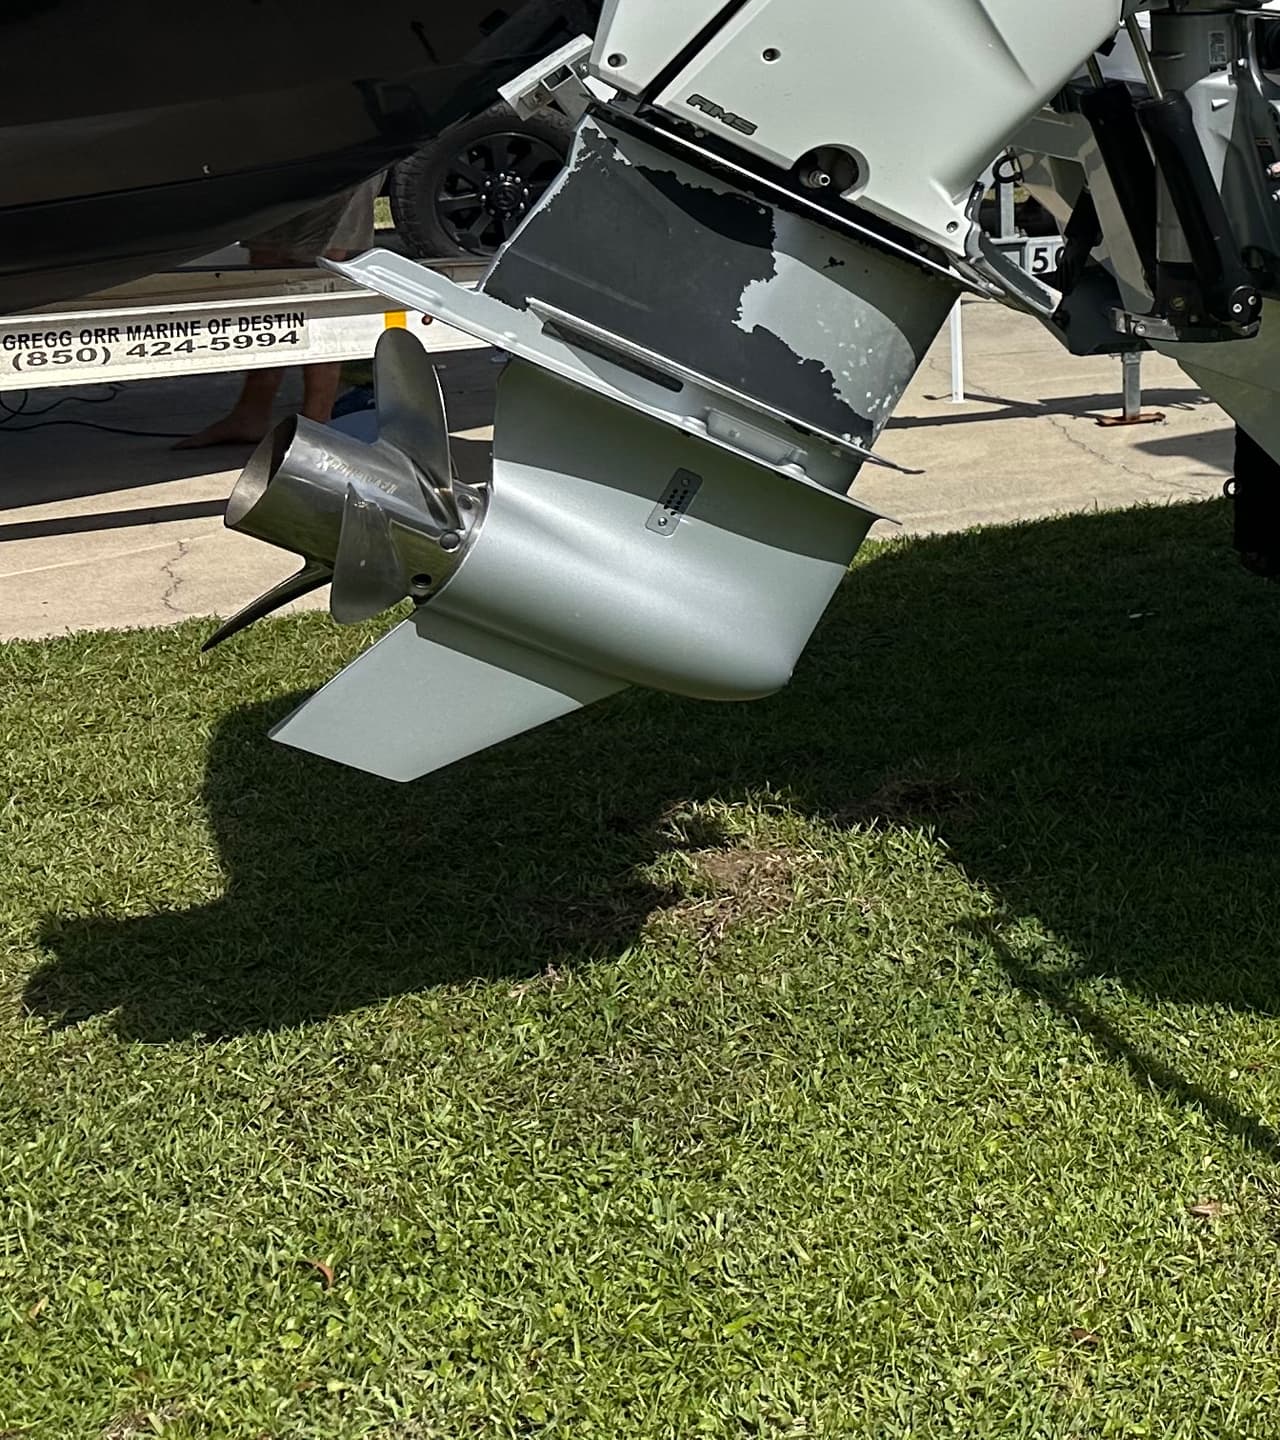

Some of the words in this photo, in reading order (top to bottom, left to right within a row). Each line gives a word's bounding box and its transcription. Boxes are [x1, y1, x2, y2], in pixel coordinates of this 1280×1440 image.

[686, 93, 758, 136] AMS
[2, 329, 72, 351] GREGG
[79, 327, 120, 345] ORR
[126, 320, 201, 342] MARINE
[207, 318, 232, 334] OF
[237, 312, 305, 333] DESTIN
[11, 345, 112, 372] (850)
[126, 329, 300, 359] 424-5994
